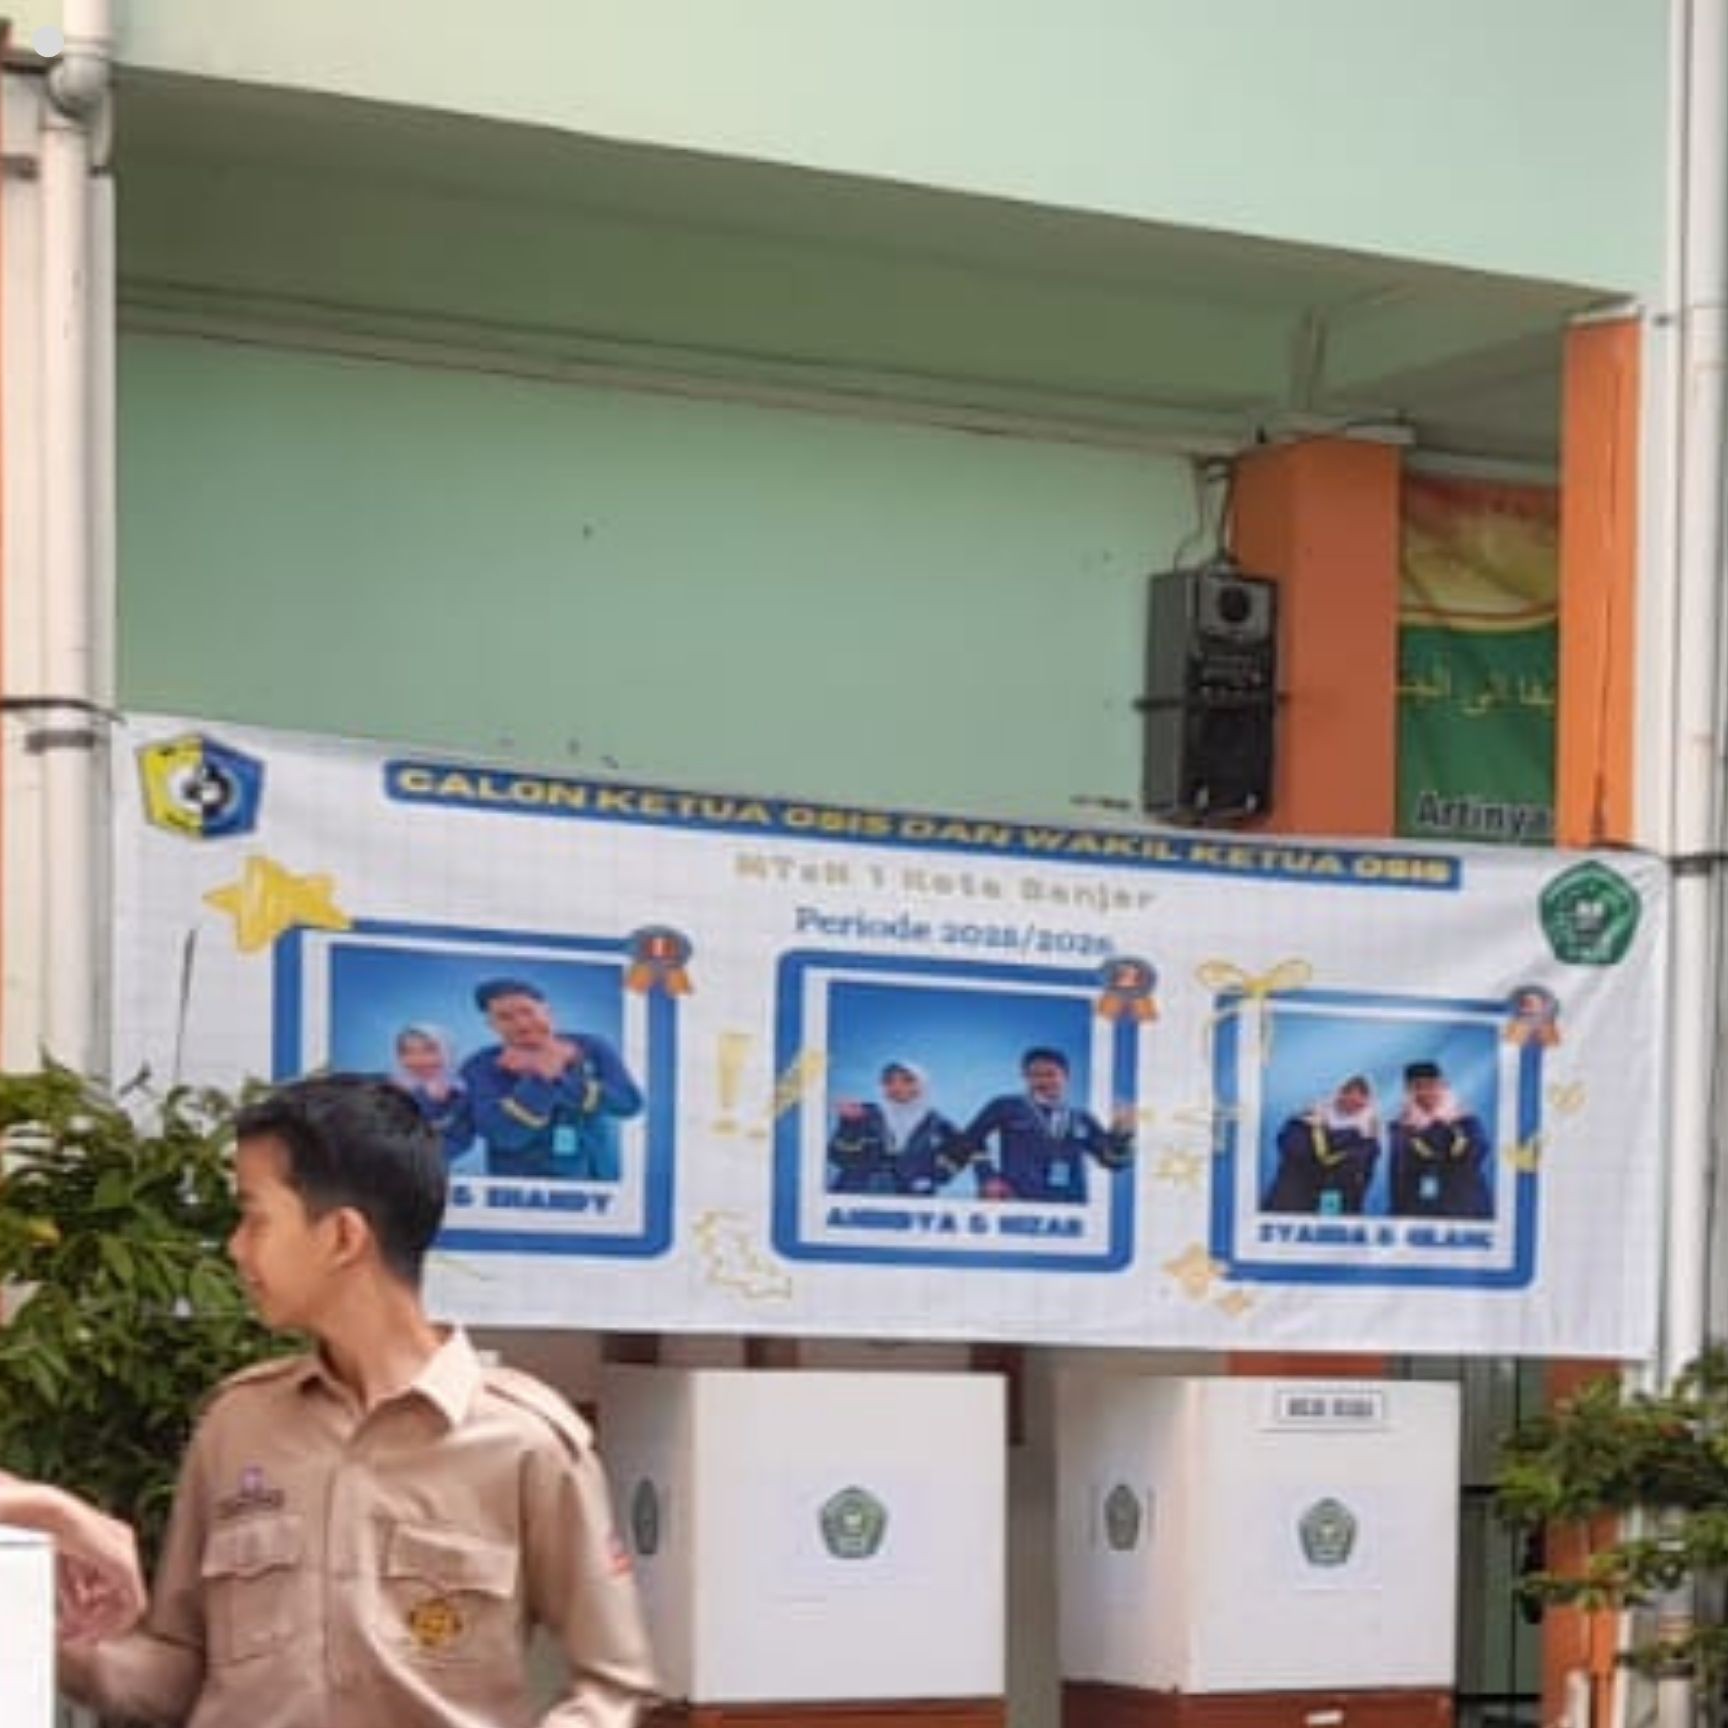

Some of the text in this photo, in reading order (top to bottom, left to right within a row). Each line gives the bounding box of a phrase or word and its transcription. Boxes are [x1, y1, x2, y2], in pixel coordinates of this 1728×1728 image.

[397, 767, 1452, 885] CALON KETUA OSIS DAN WAKIL KETUA OSIS
[1019, 876, 1159, 913] Banjar
[794, 906, 932, 941] Periode
